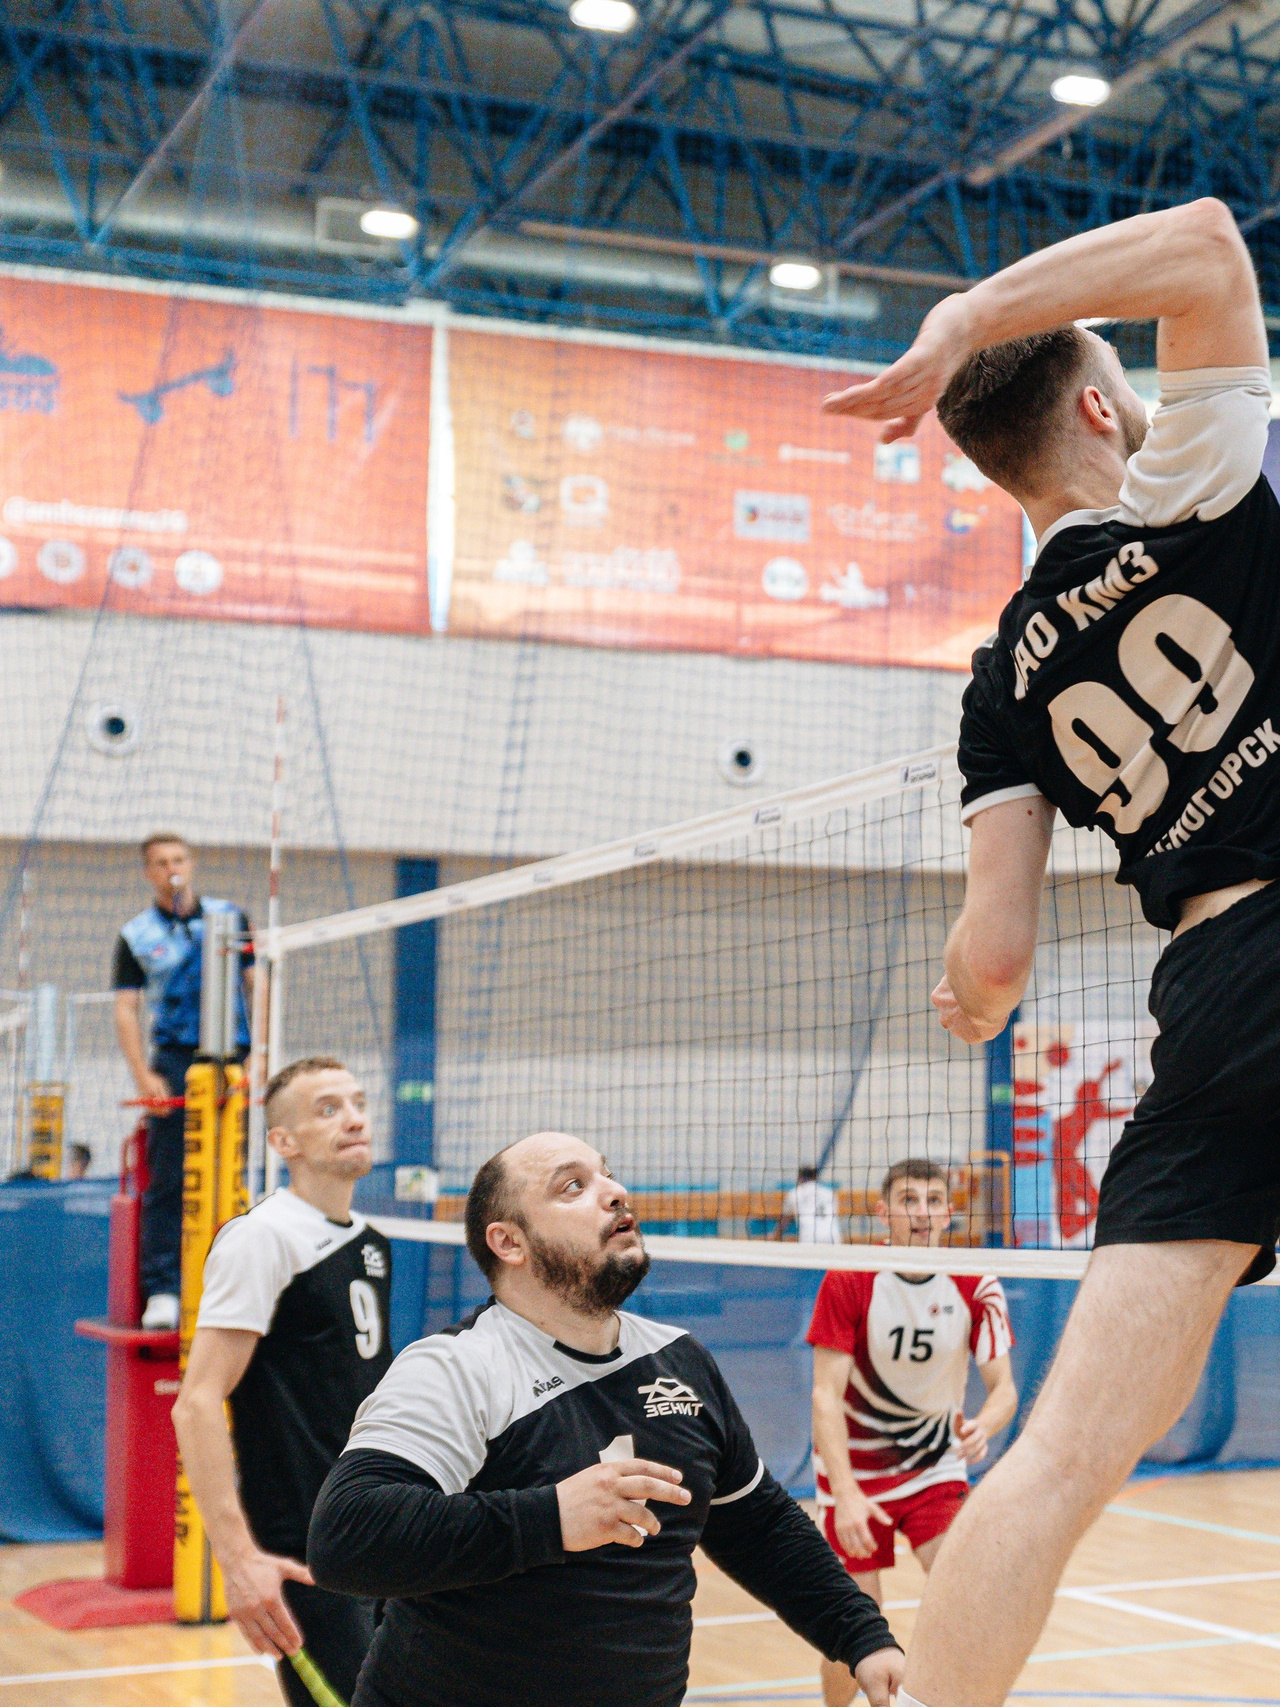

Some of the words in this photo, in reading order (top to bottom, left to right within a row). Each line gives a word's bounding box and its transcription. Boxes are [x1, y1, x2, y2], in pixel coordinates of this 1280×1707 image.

[1046, 593, 1256, 835] 99
[348, 1278, 381, 1360] 9
[888, 1325, 935, 1363] 15
[643, 1402, 704, 1418] ЗЕНИТ
